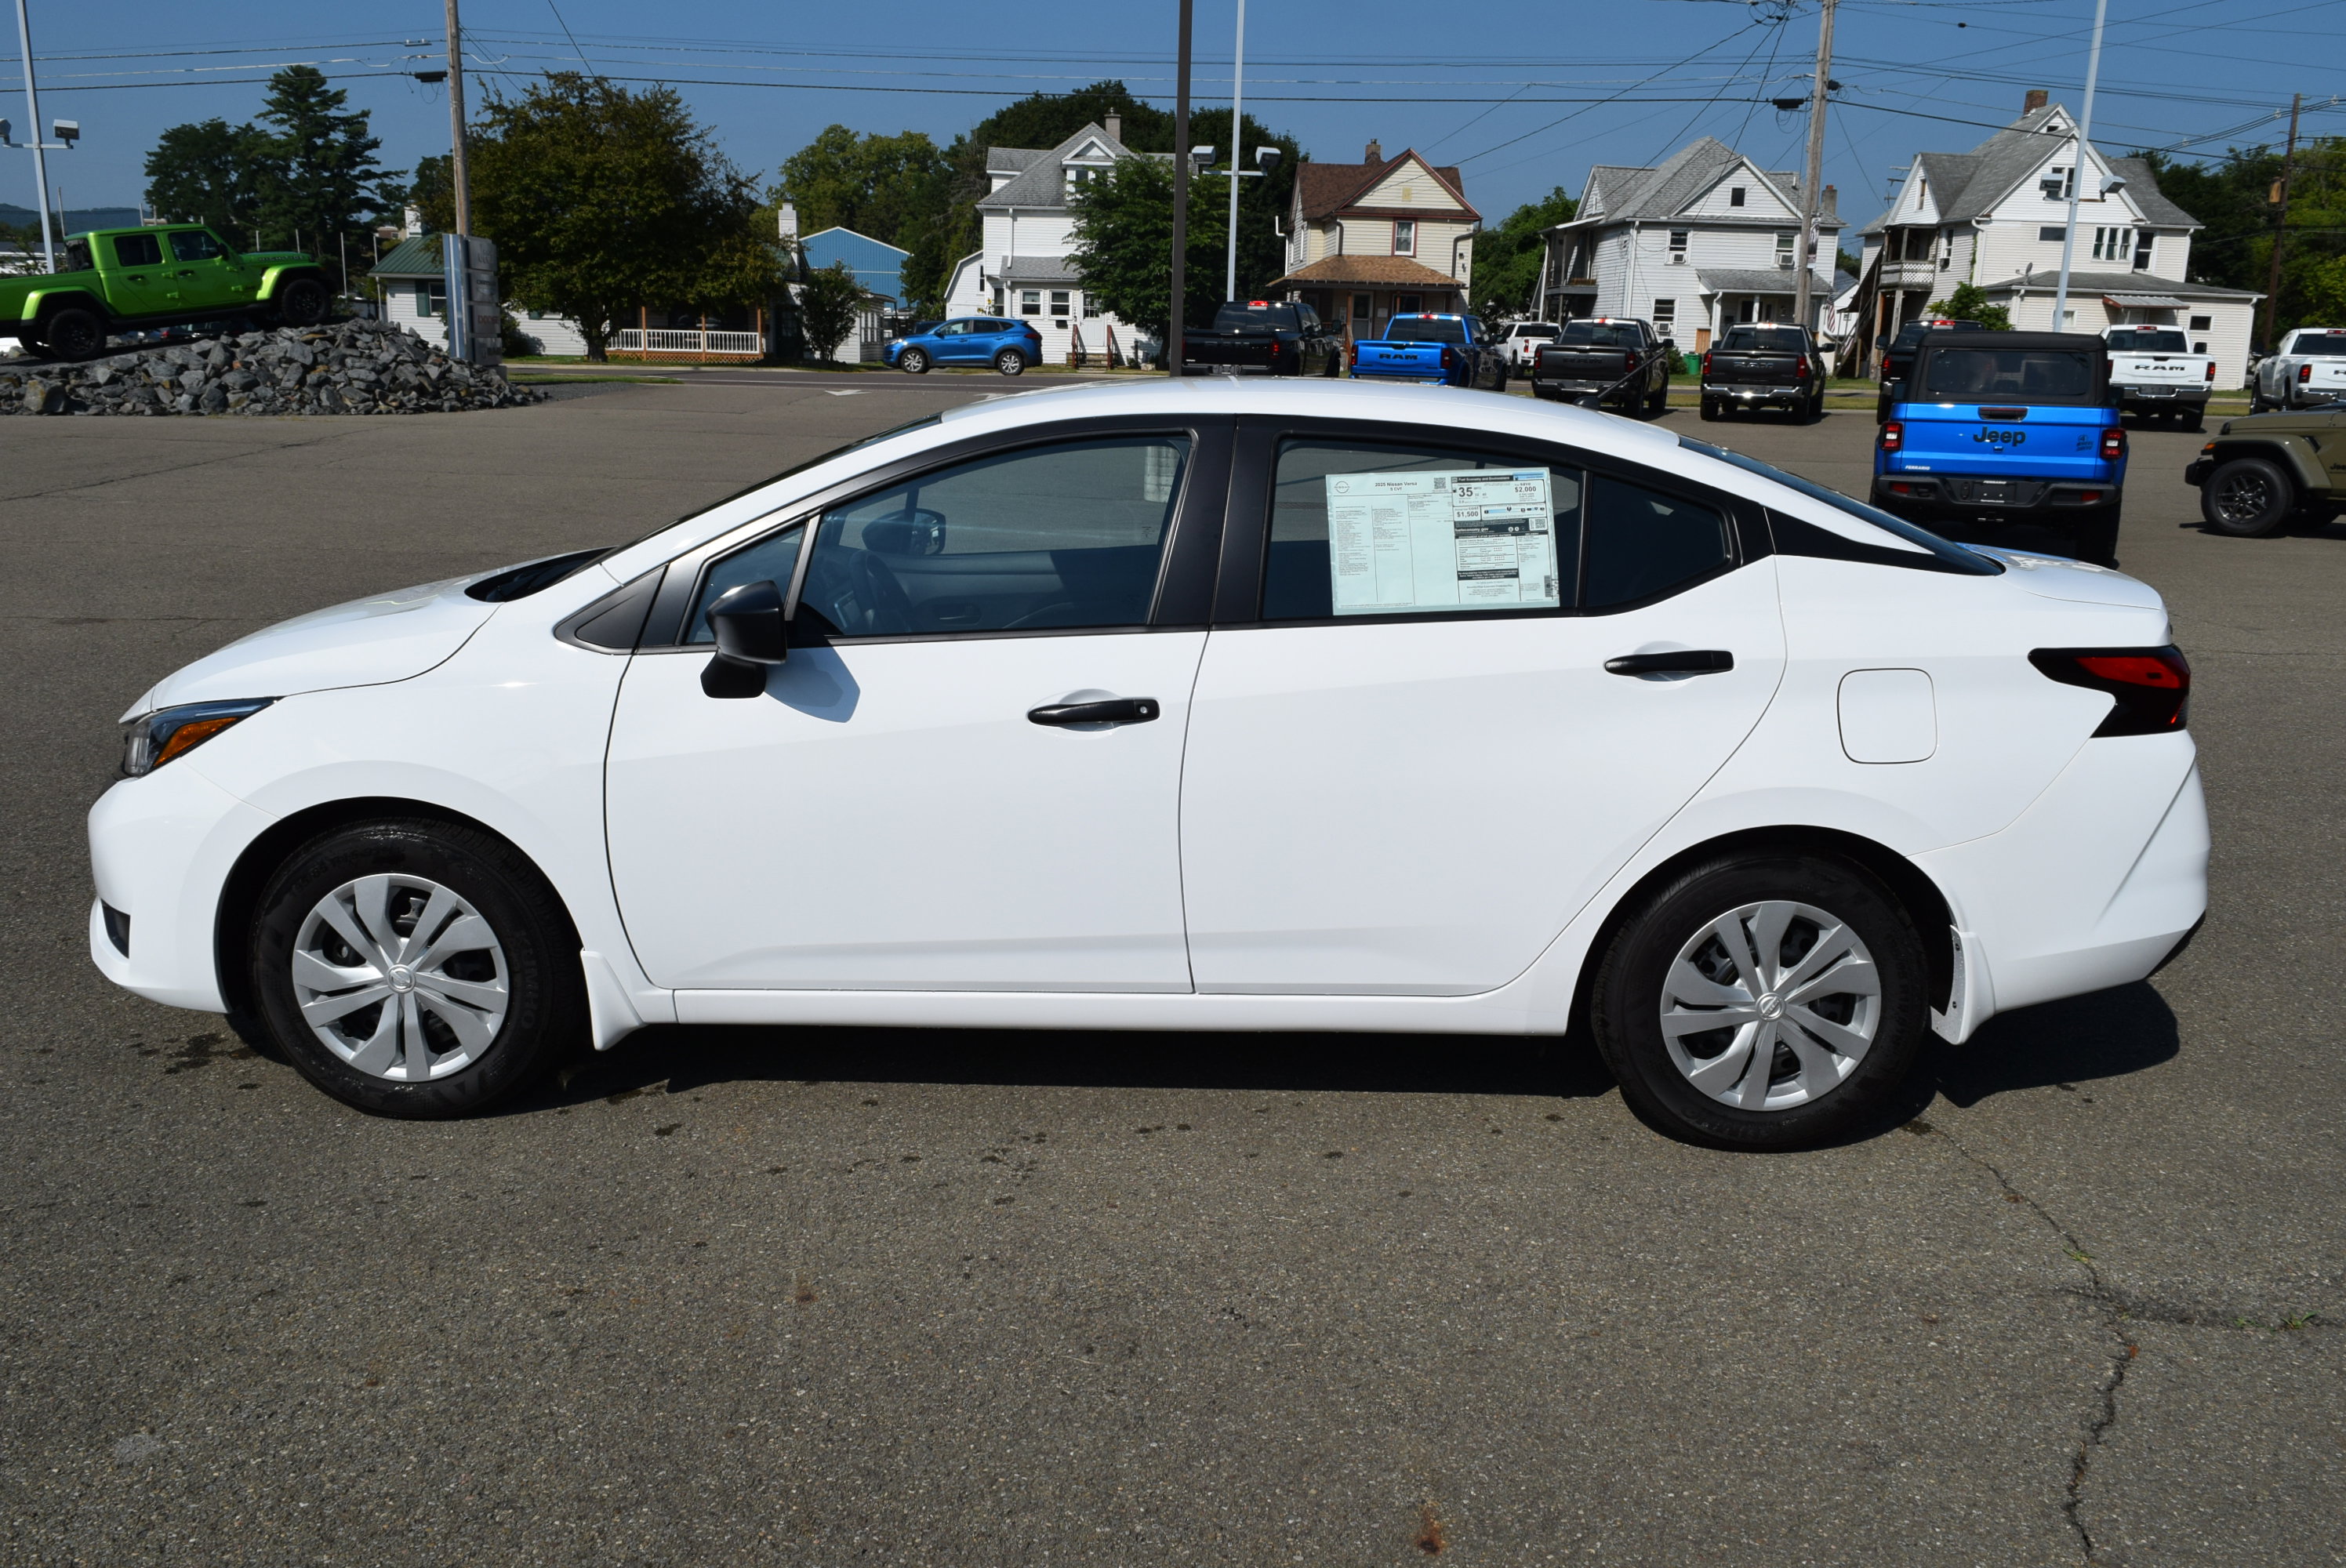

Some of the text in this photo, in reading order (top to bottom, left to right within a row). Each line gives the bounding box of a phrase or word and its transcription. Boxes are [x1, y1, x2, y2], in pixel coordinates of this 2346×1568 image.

[478, 314, 499, 325] DODGE
[1973, 426, 2026, 447] Jeep
[1458, 487, 1473, 497] 35
